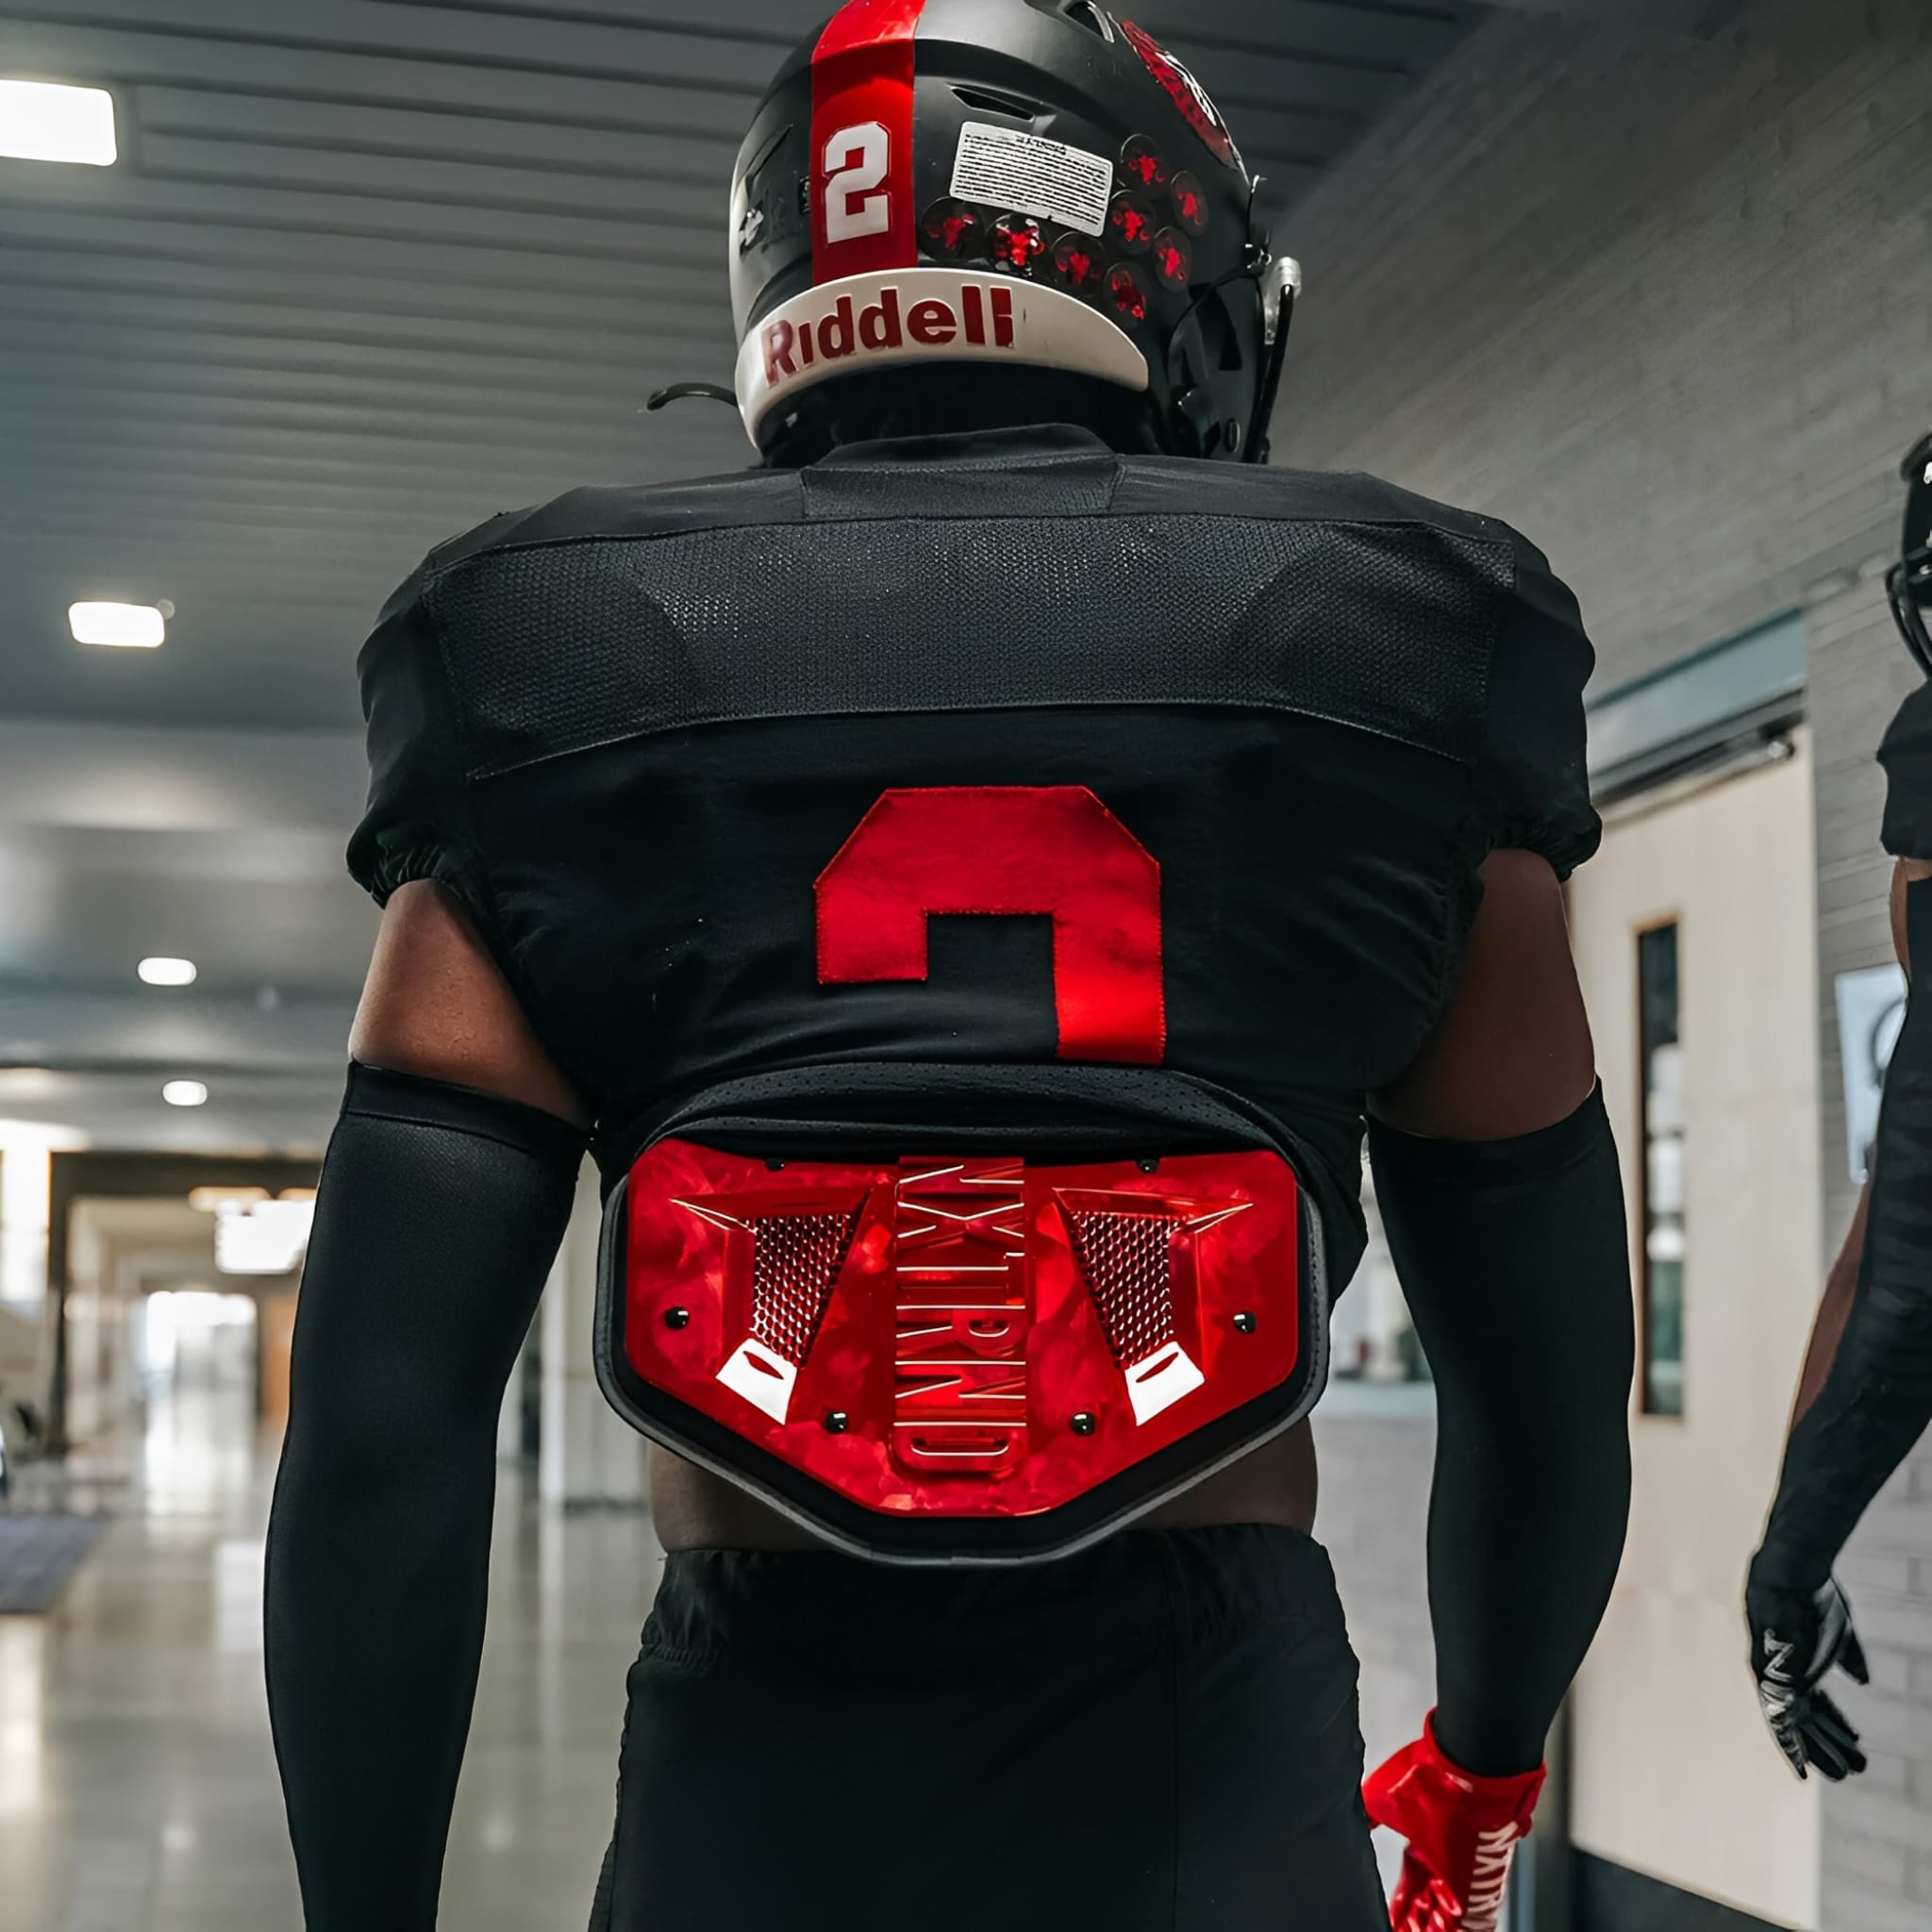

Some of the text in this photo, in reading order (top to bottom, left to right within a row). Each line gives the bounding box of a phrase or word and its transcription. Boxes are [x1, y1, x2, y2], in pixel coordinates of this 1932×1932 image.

[824, 122, 889, 243] 2
[761, 284, 1015, 388] Riddell
[895, 1157, 1026, 1472] NXTRND
